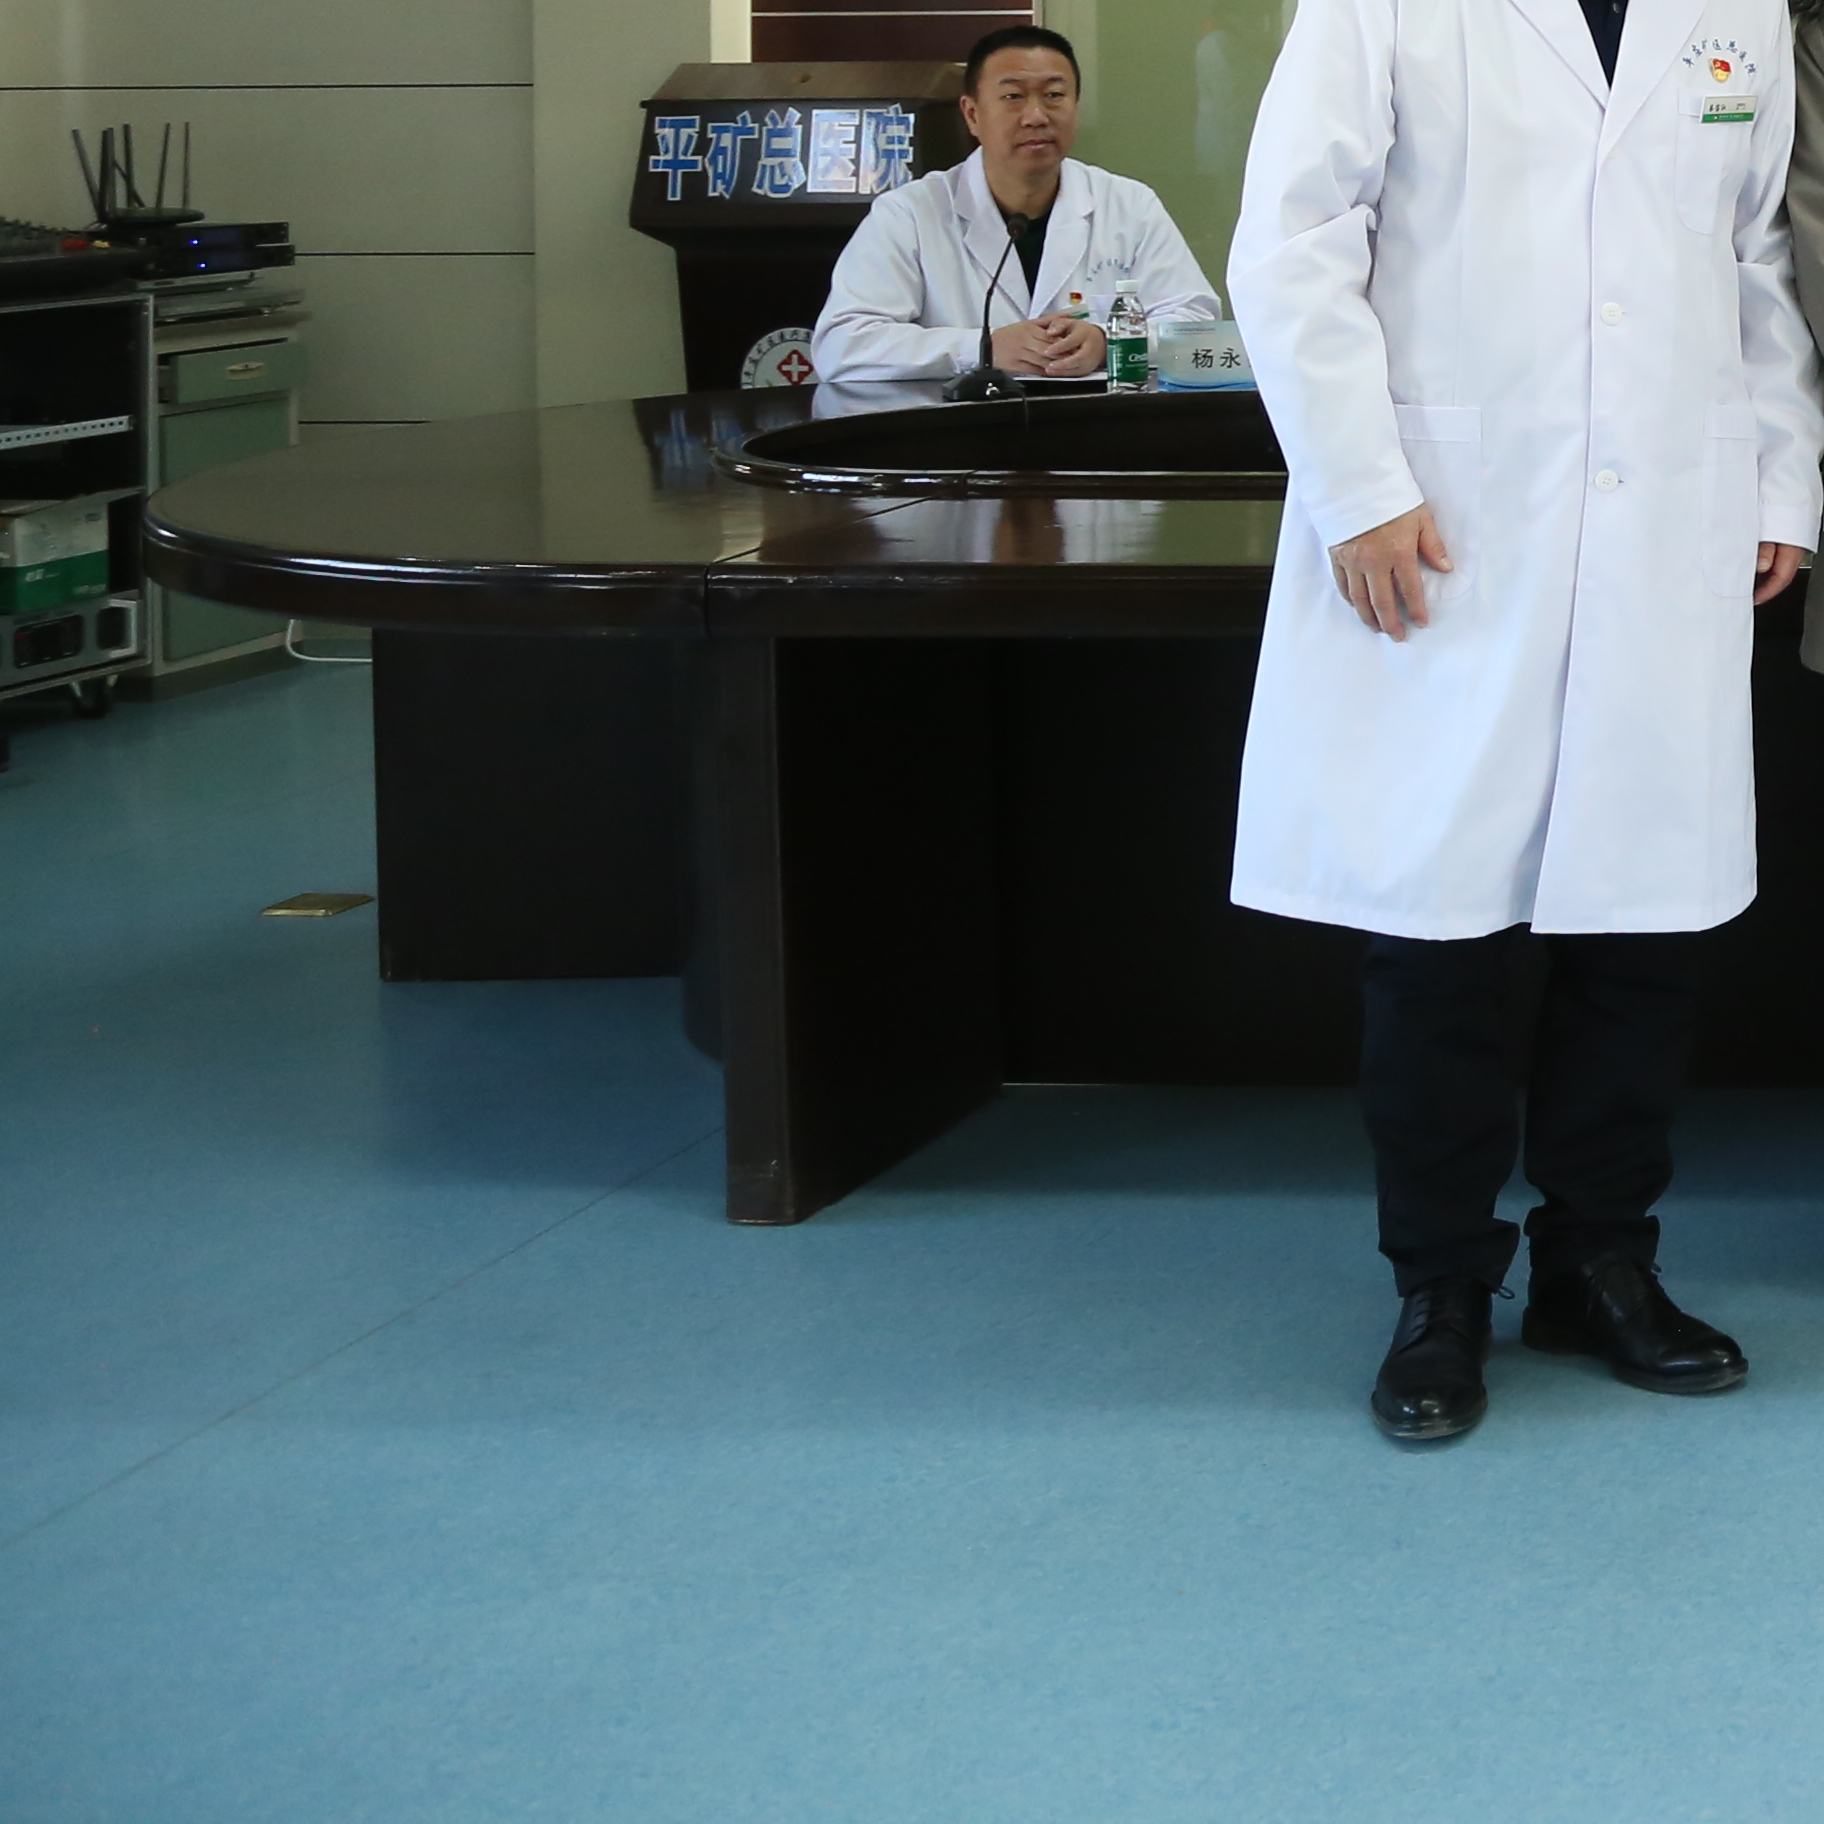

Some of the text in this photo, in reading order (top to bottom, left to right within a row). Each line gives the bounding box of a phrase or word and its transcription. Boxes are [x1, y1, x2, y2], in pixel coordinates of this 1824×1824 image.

[649, 102, 916, 201] 平矿总医院
